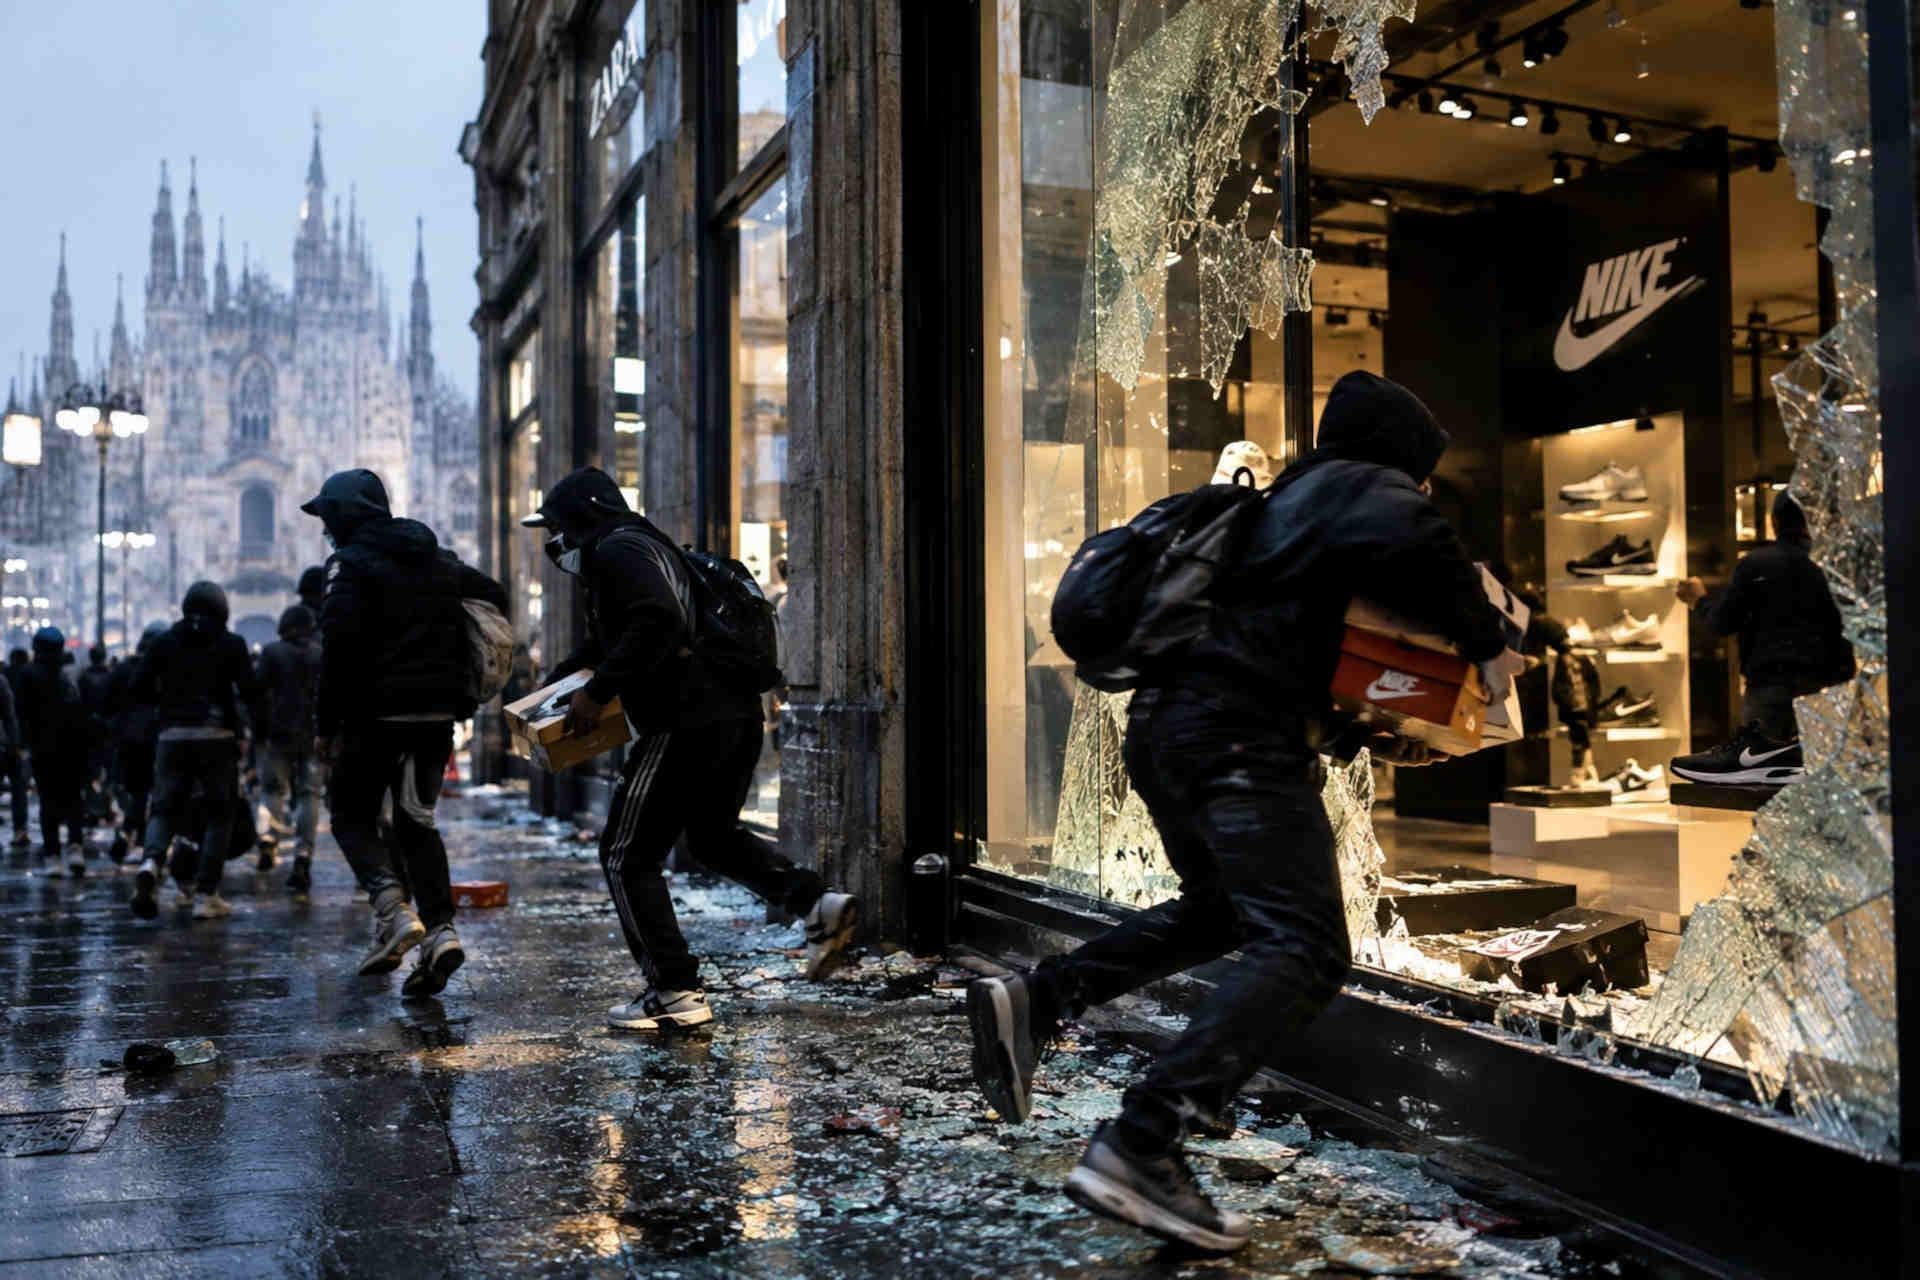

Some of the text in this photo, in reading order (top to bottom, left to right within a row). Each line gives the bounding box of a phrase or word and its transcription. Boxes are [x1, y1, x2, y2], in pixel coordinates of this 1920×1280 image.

[589, 20, 639, 139] ZARA
[1574, 238, 1679, 323] NIKE
[1377, 669, 1420, 692] NIKE
